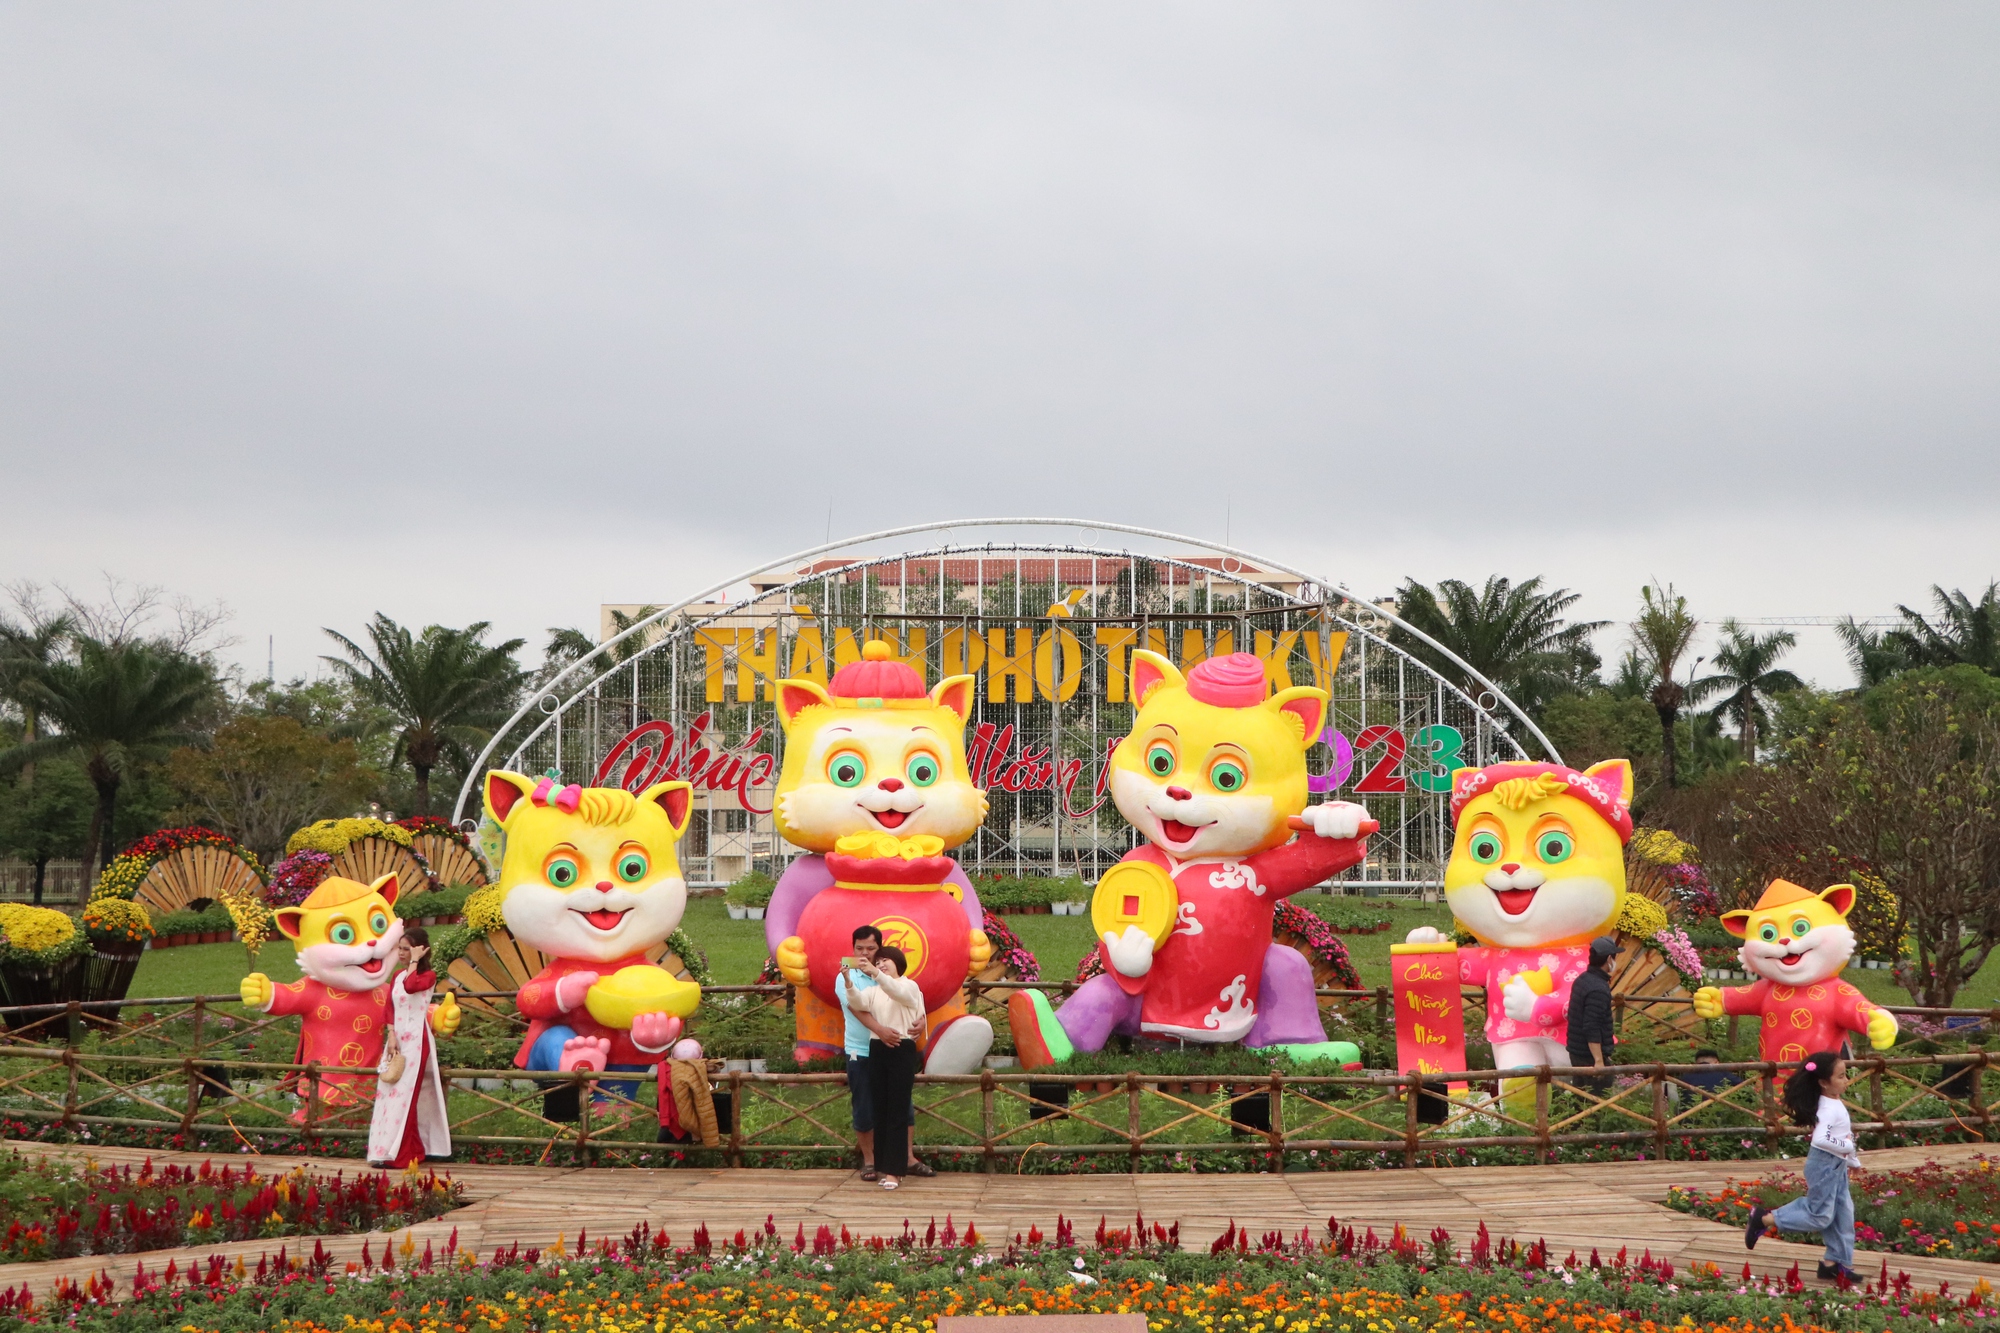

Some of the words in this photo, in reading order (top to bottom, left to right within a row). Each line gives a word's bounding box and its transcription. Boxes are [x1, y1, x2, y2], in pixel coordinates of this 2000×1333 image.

[943, 588, 1087, 704] PHỐ
[590, 710, 775, 815] Chúc
[1307, 724, 1468, 794] 023
[1403, 962, 1445, 982] Chúc
[1405, 990, 1454, 1018] Mừng
[1413, 1022, 1447, 1048] Năm
